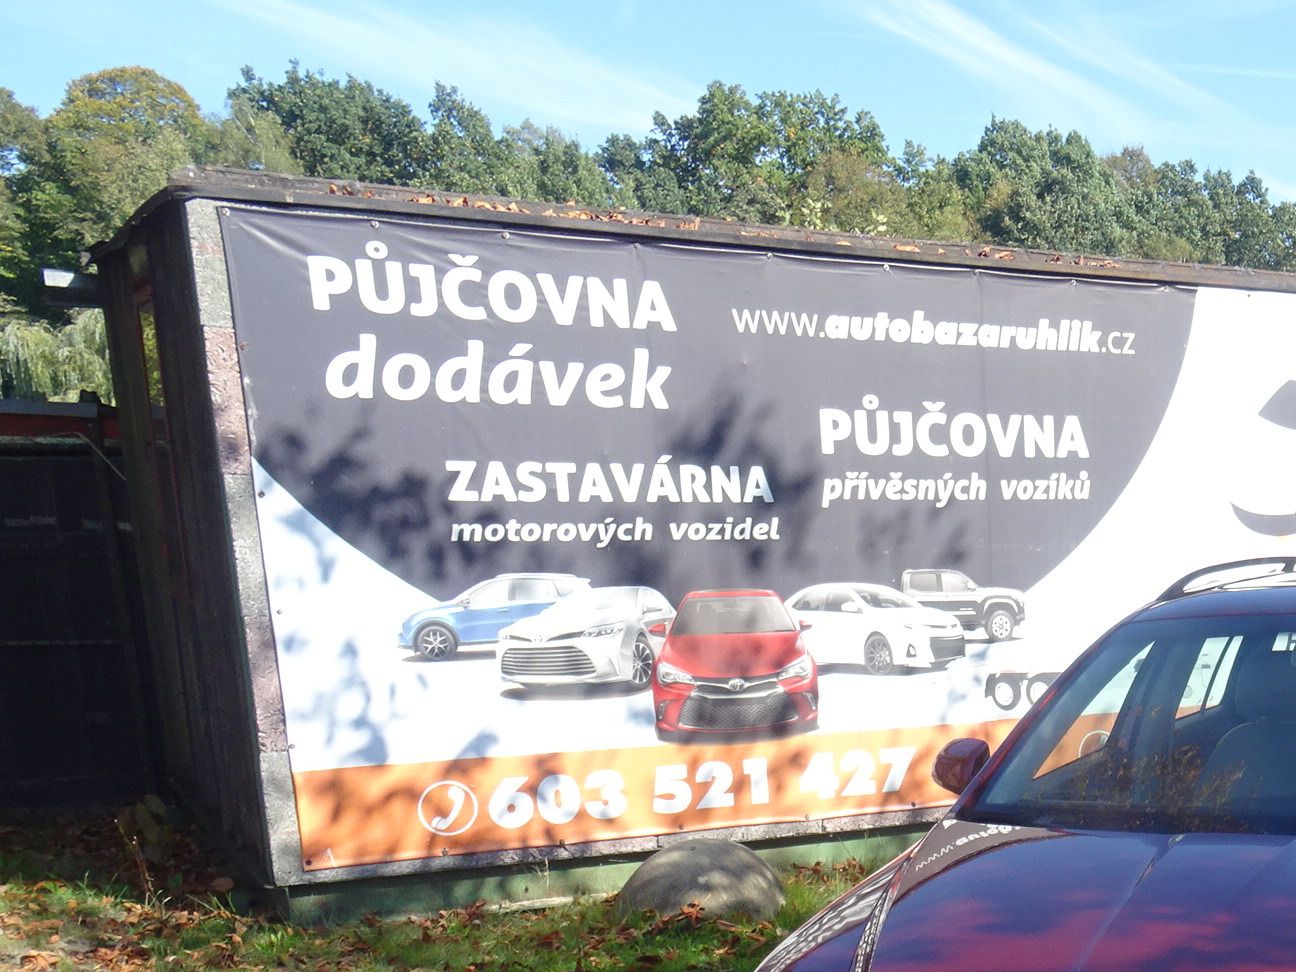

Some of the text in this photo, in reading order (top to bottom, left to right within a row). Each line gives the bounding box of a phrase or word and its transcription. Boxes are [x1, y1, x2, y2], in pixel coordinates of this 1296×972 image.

[306, 240, 678, 332] PŮJČOVNA
[731, 308, 1136, 355] www.autobazaruhlik.cz
[324, 333, 672, 409] dodávek
[818, 394, 1091, 459] PŮJČOVNA
[445, 454, 775, 504] ZASTAVÁRNA
[821, 470, 1091, 508] přívěsných vozíků
[450, 515, 780, 548] motorových vozidel
[488, 747, 916, 829] 603 521 427
